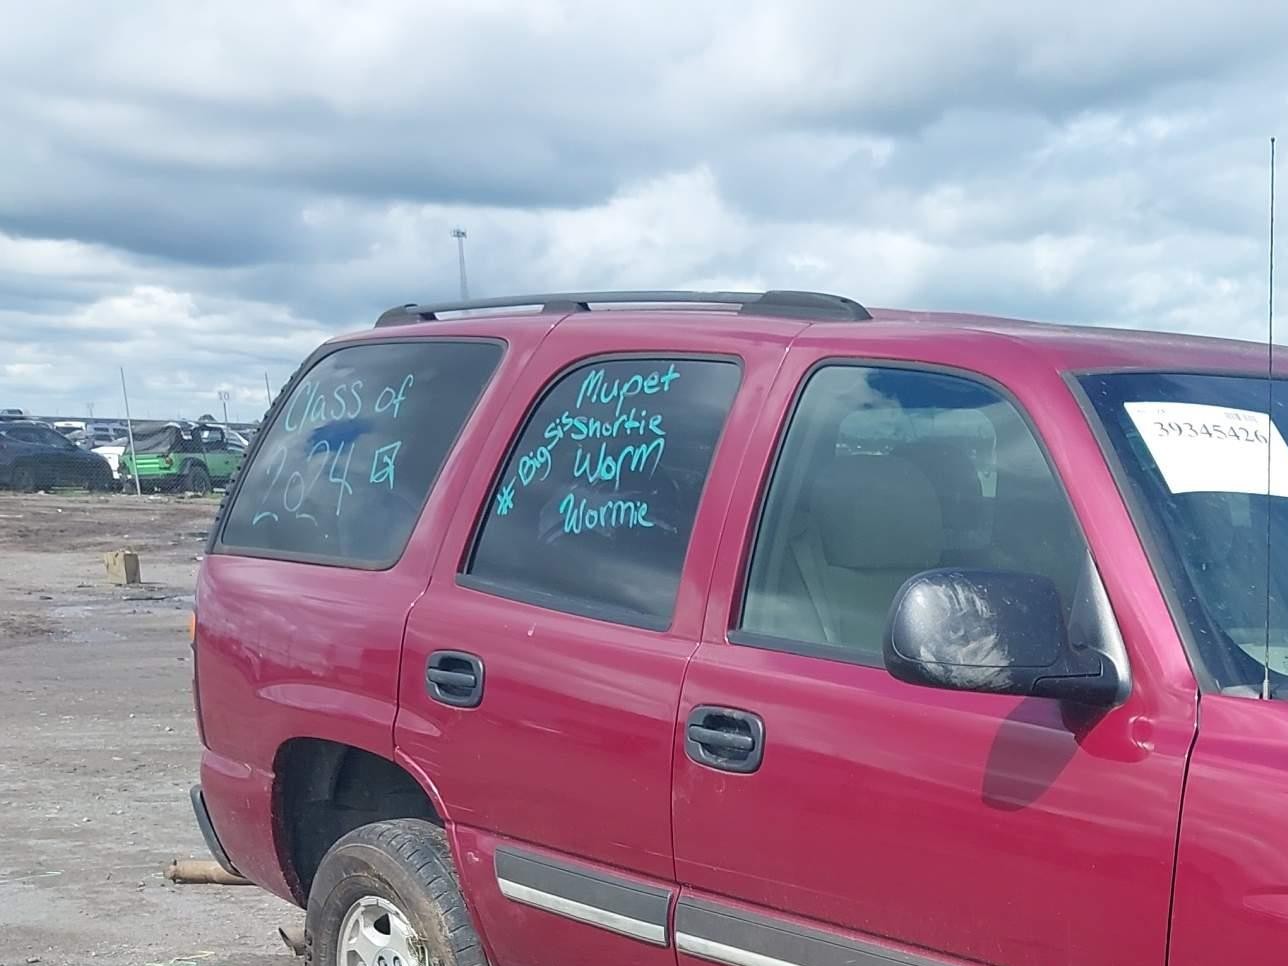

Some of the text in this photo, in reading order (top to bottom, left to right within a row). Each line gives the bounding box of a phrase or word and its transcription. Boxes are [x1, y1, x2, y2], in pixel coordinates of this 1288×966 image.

[285, 374, 414, 433] Class of
[576, 364, 681, 416] Mupet
[1153, 421, 1269, 444] 39345426
[559, 493, 654, 534] Wormie
